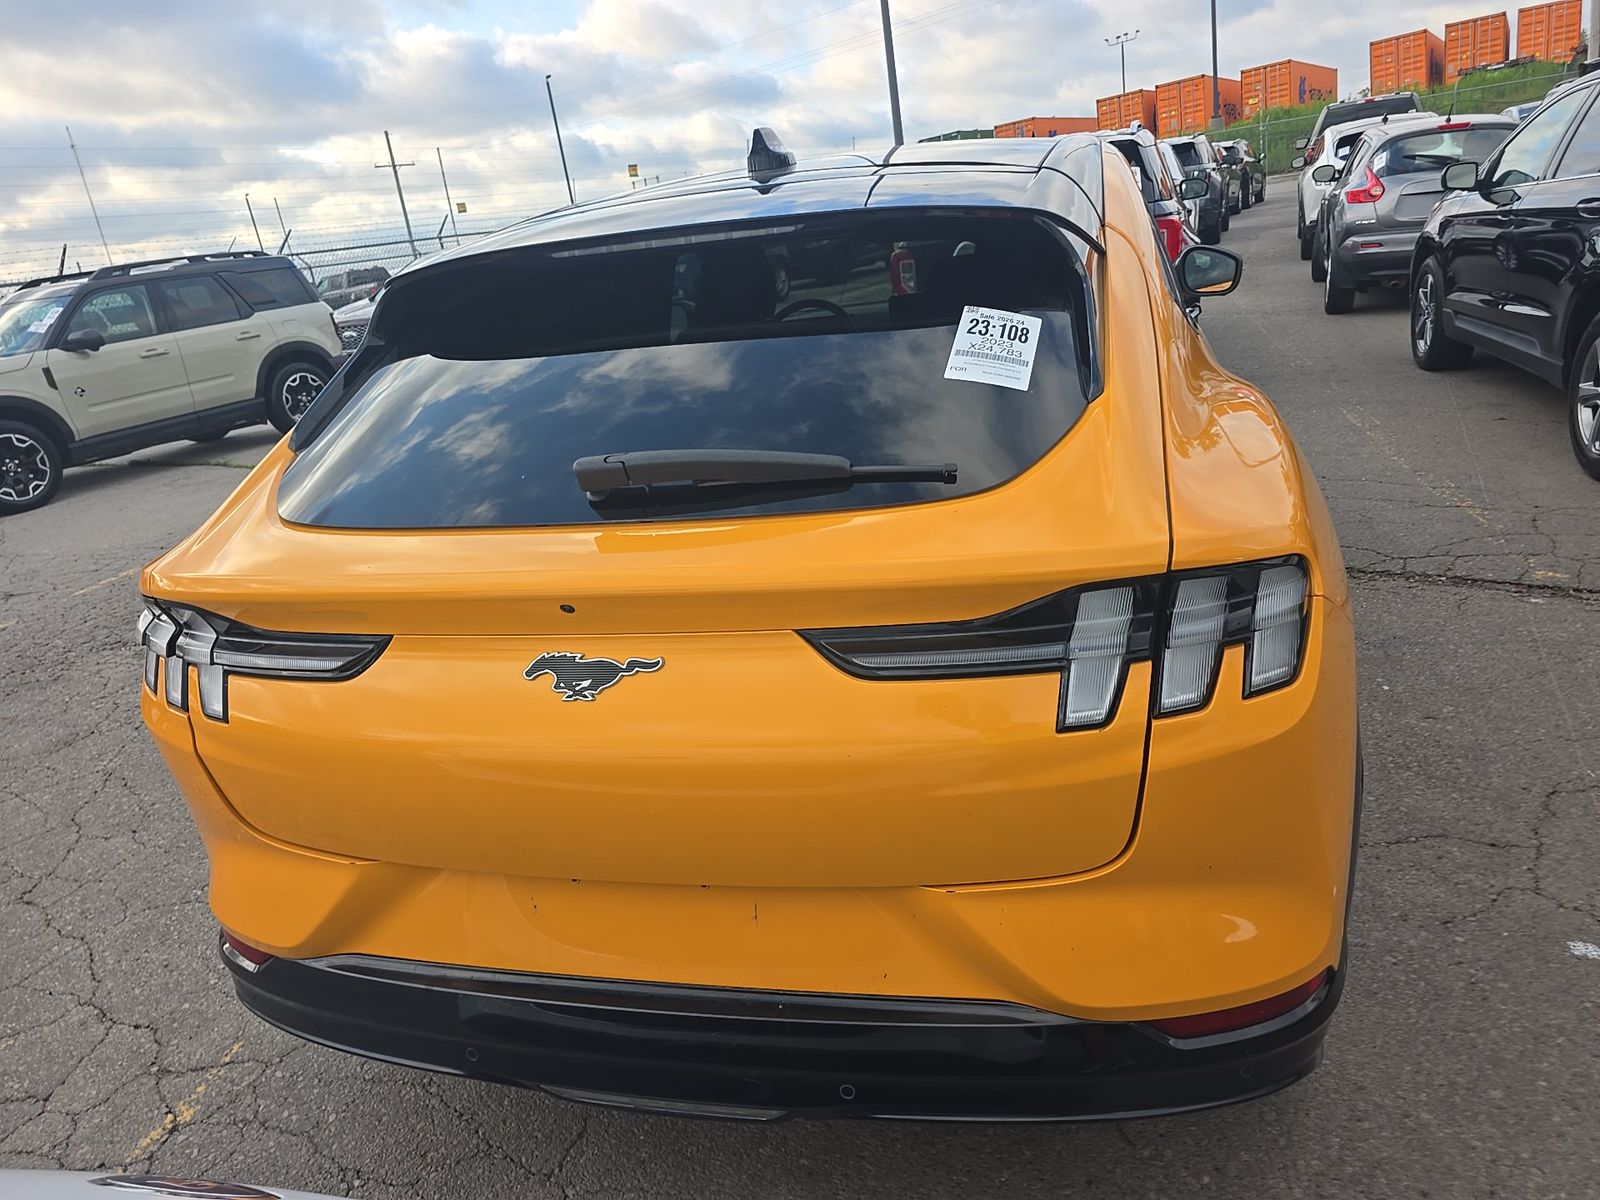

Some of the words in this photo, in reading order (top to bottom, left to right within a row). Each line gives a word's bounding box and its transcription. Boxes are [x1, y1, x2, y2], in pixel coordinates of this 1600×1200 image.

[979, 312, 995, 321] Sale
[966, 318, 1030, 344] 23:108
[980, 337, 1014, 349] 2023
